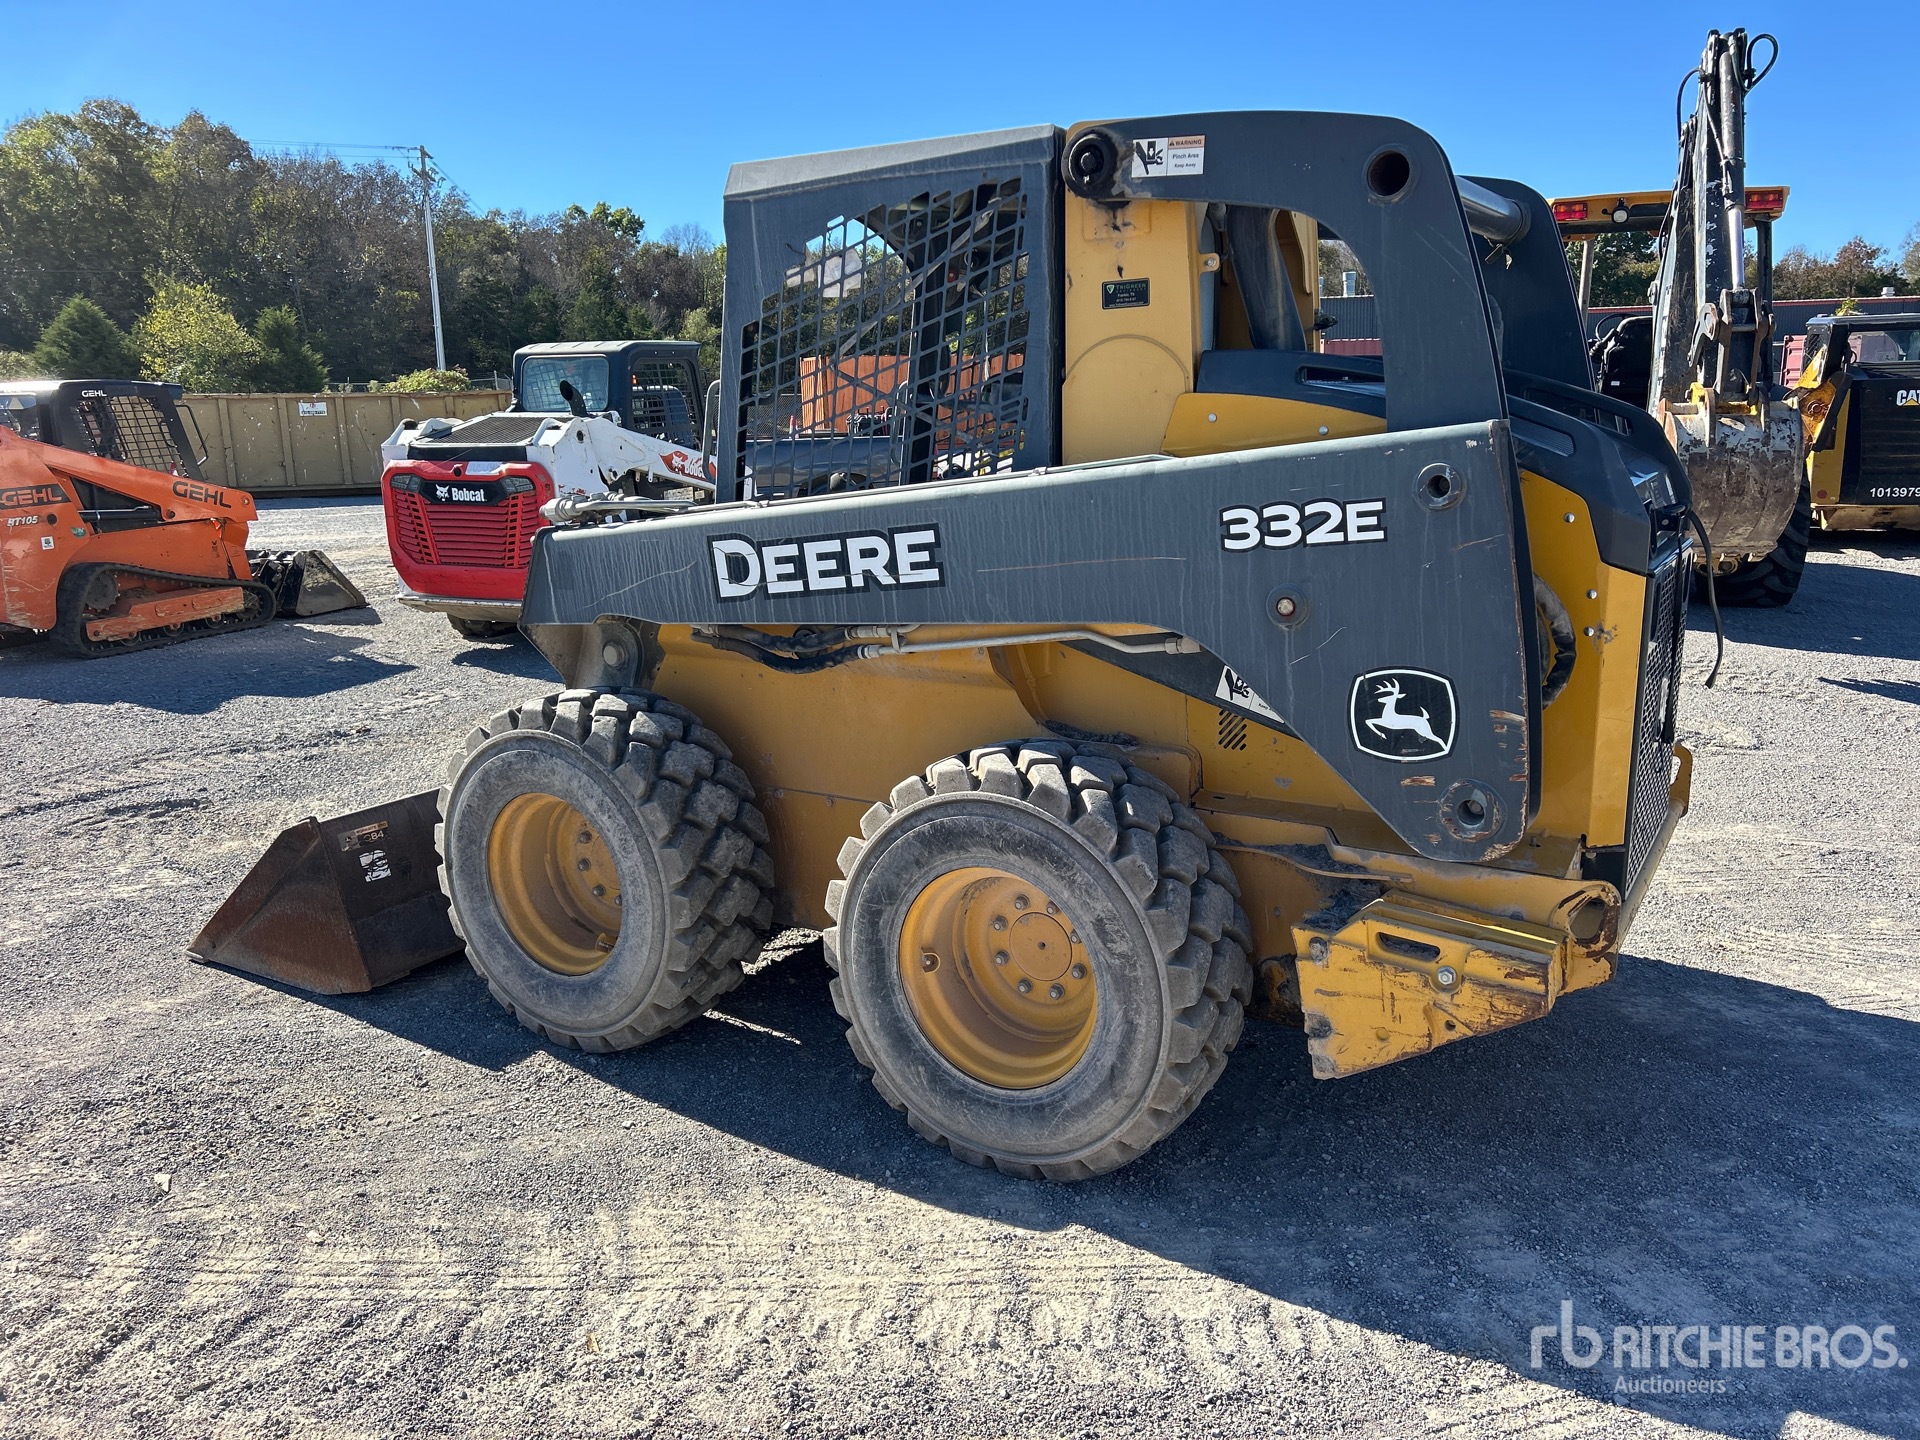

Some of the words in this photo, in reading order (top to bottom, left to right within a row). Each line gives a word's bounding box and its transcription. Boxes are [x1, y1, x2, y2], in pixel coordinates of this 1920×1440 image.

[81, 390, 108, 398] GEHL
[2, 488, 62, 506] GEHL
[172, 481, 232, 509] GEHL
[451, 487, 485, 502] Bobcat
[1222, 501, 1385, 550] 332E
[712, 530, 940, 598] DEERE
